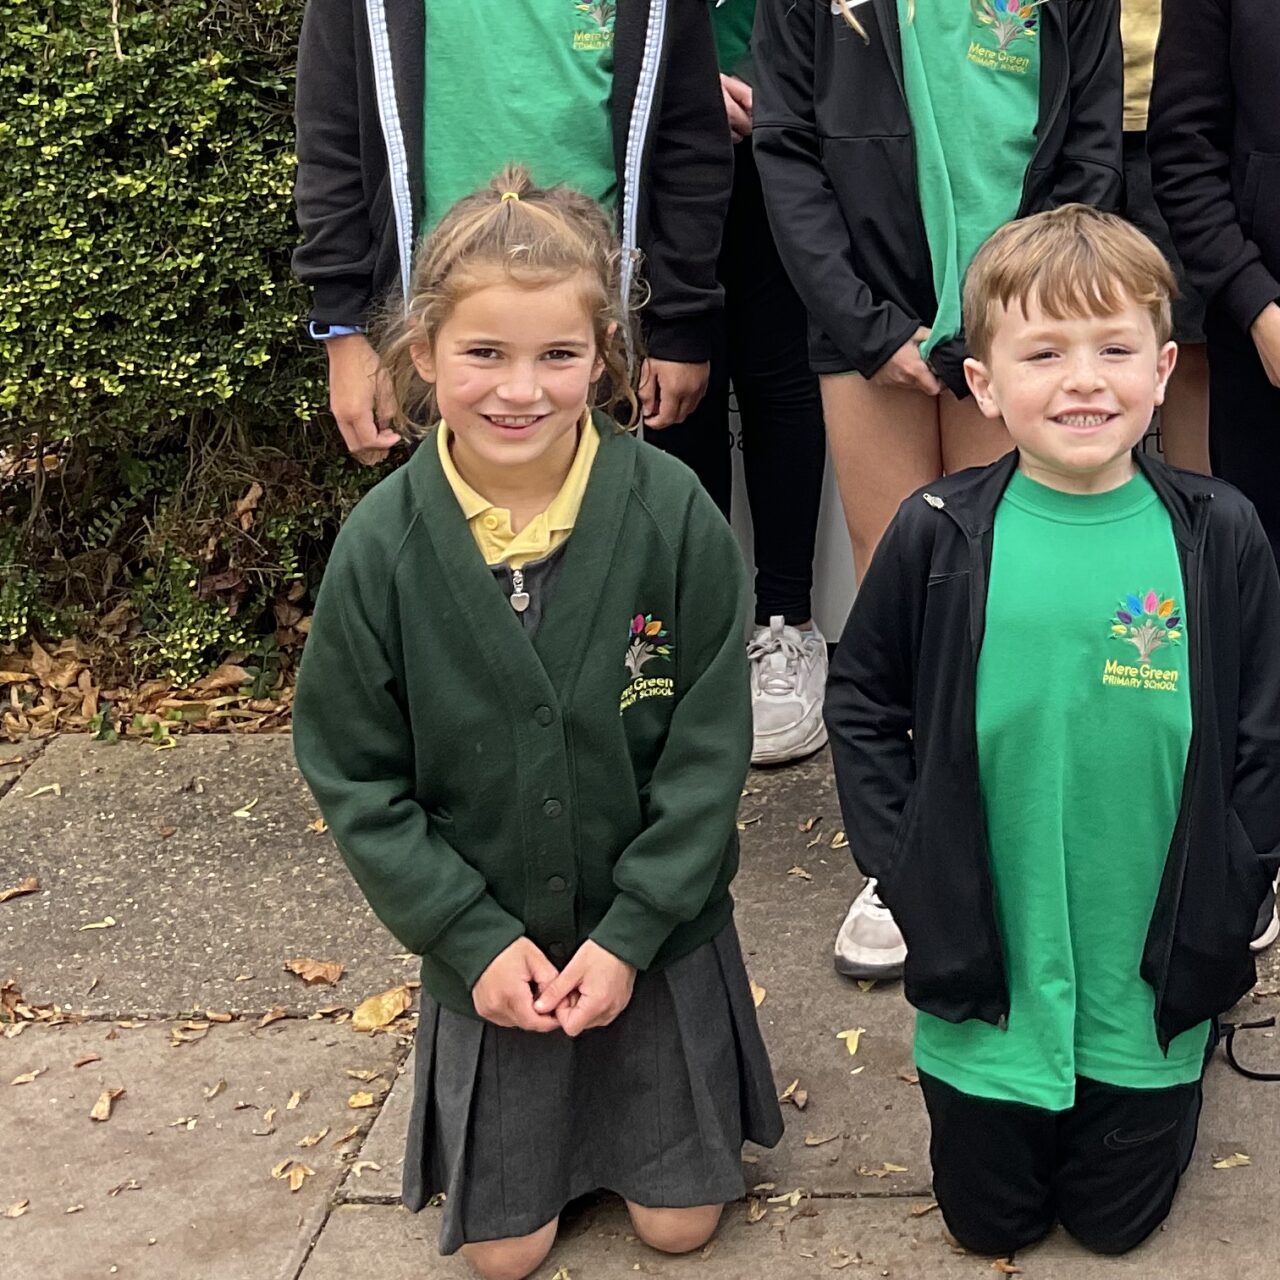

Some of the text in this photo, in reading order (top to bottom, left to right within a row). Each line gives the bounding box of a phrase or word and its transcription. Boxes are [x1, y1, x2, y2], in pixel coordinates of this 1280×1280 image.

[1104, 659, 1178, 681] Mere Green
[634, 677, 674, 691] Green
[1103, 674, 1178, 692] PRIMARY SCHOOL
[640, 688, 675, 699] SCHOOL
